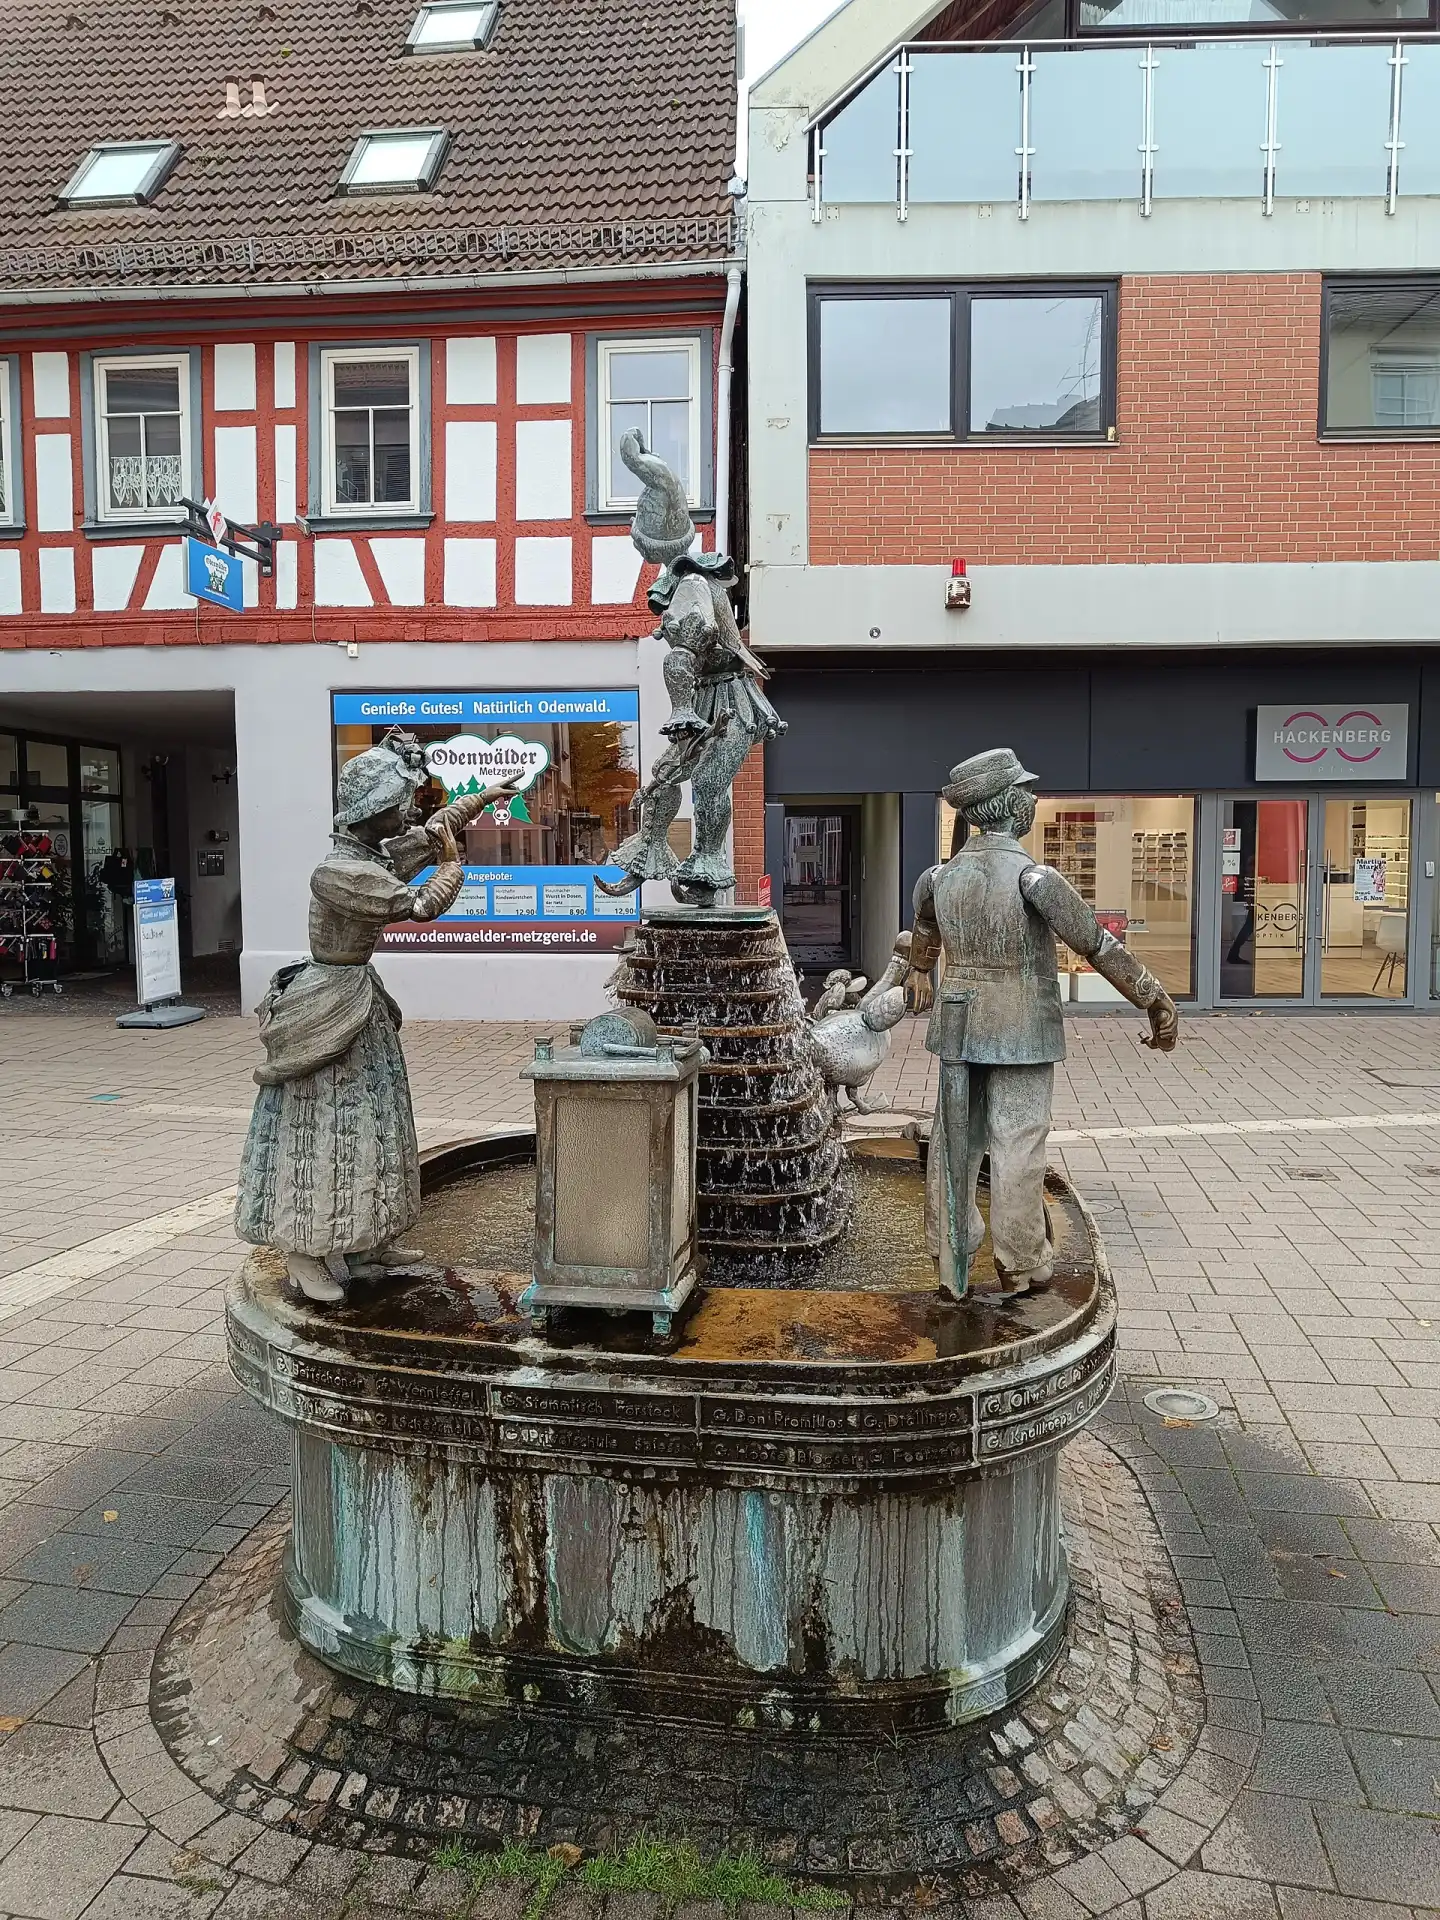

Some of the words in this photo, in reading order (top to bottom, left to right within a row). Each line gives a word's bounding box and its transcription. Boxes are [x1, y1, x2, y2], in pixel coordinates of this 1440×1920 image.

[360, 701, 416, 716] Genieße
[420, 701, 464, 715] Gutes!
[473, 700, 533, 715] Natürlich
[538, 699, 611, 714] Odenwald.
[1273, 729, 1391, 744] HACKENBERG
[431, 748, 537, 766] Odenwälder
[467, 871, 512, 882] Angebote:
[382, 929, 597, 945] www.odenwaelder-metzgerei.de
[525, 1396, 603, 1415] Stammtisch
[987, 1399, 1002, 1413] G.
[713, 1408, 730, 1422] G.
[735, 1408, 765, 1425] Don
[773, 1410, 843, 1429] Promillos
[986, 1435, 1002, 1449] G.
